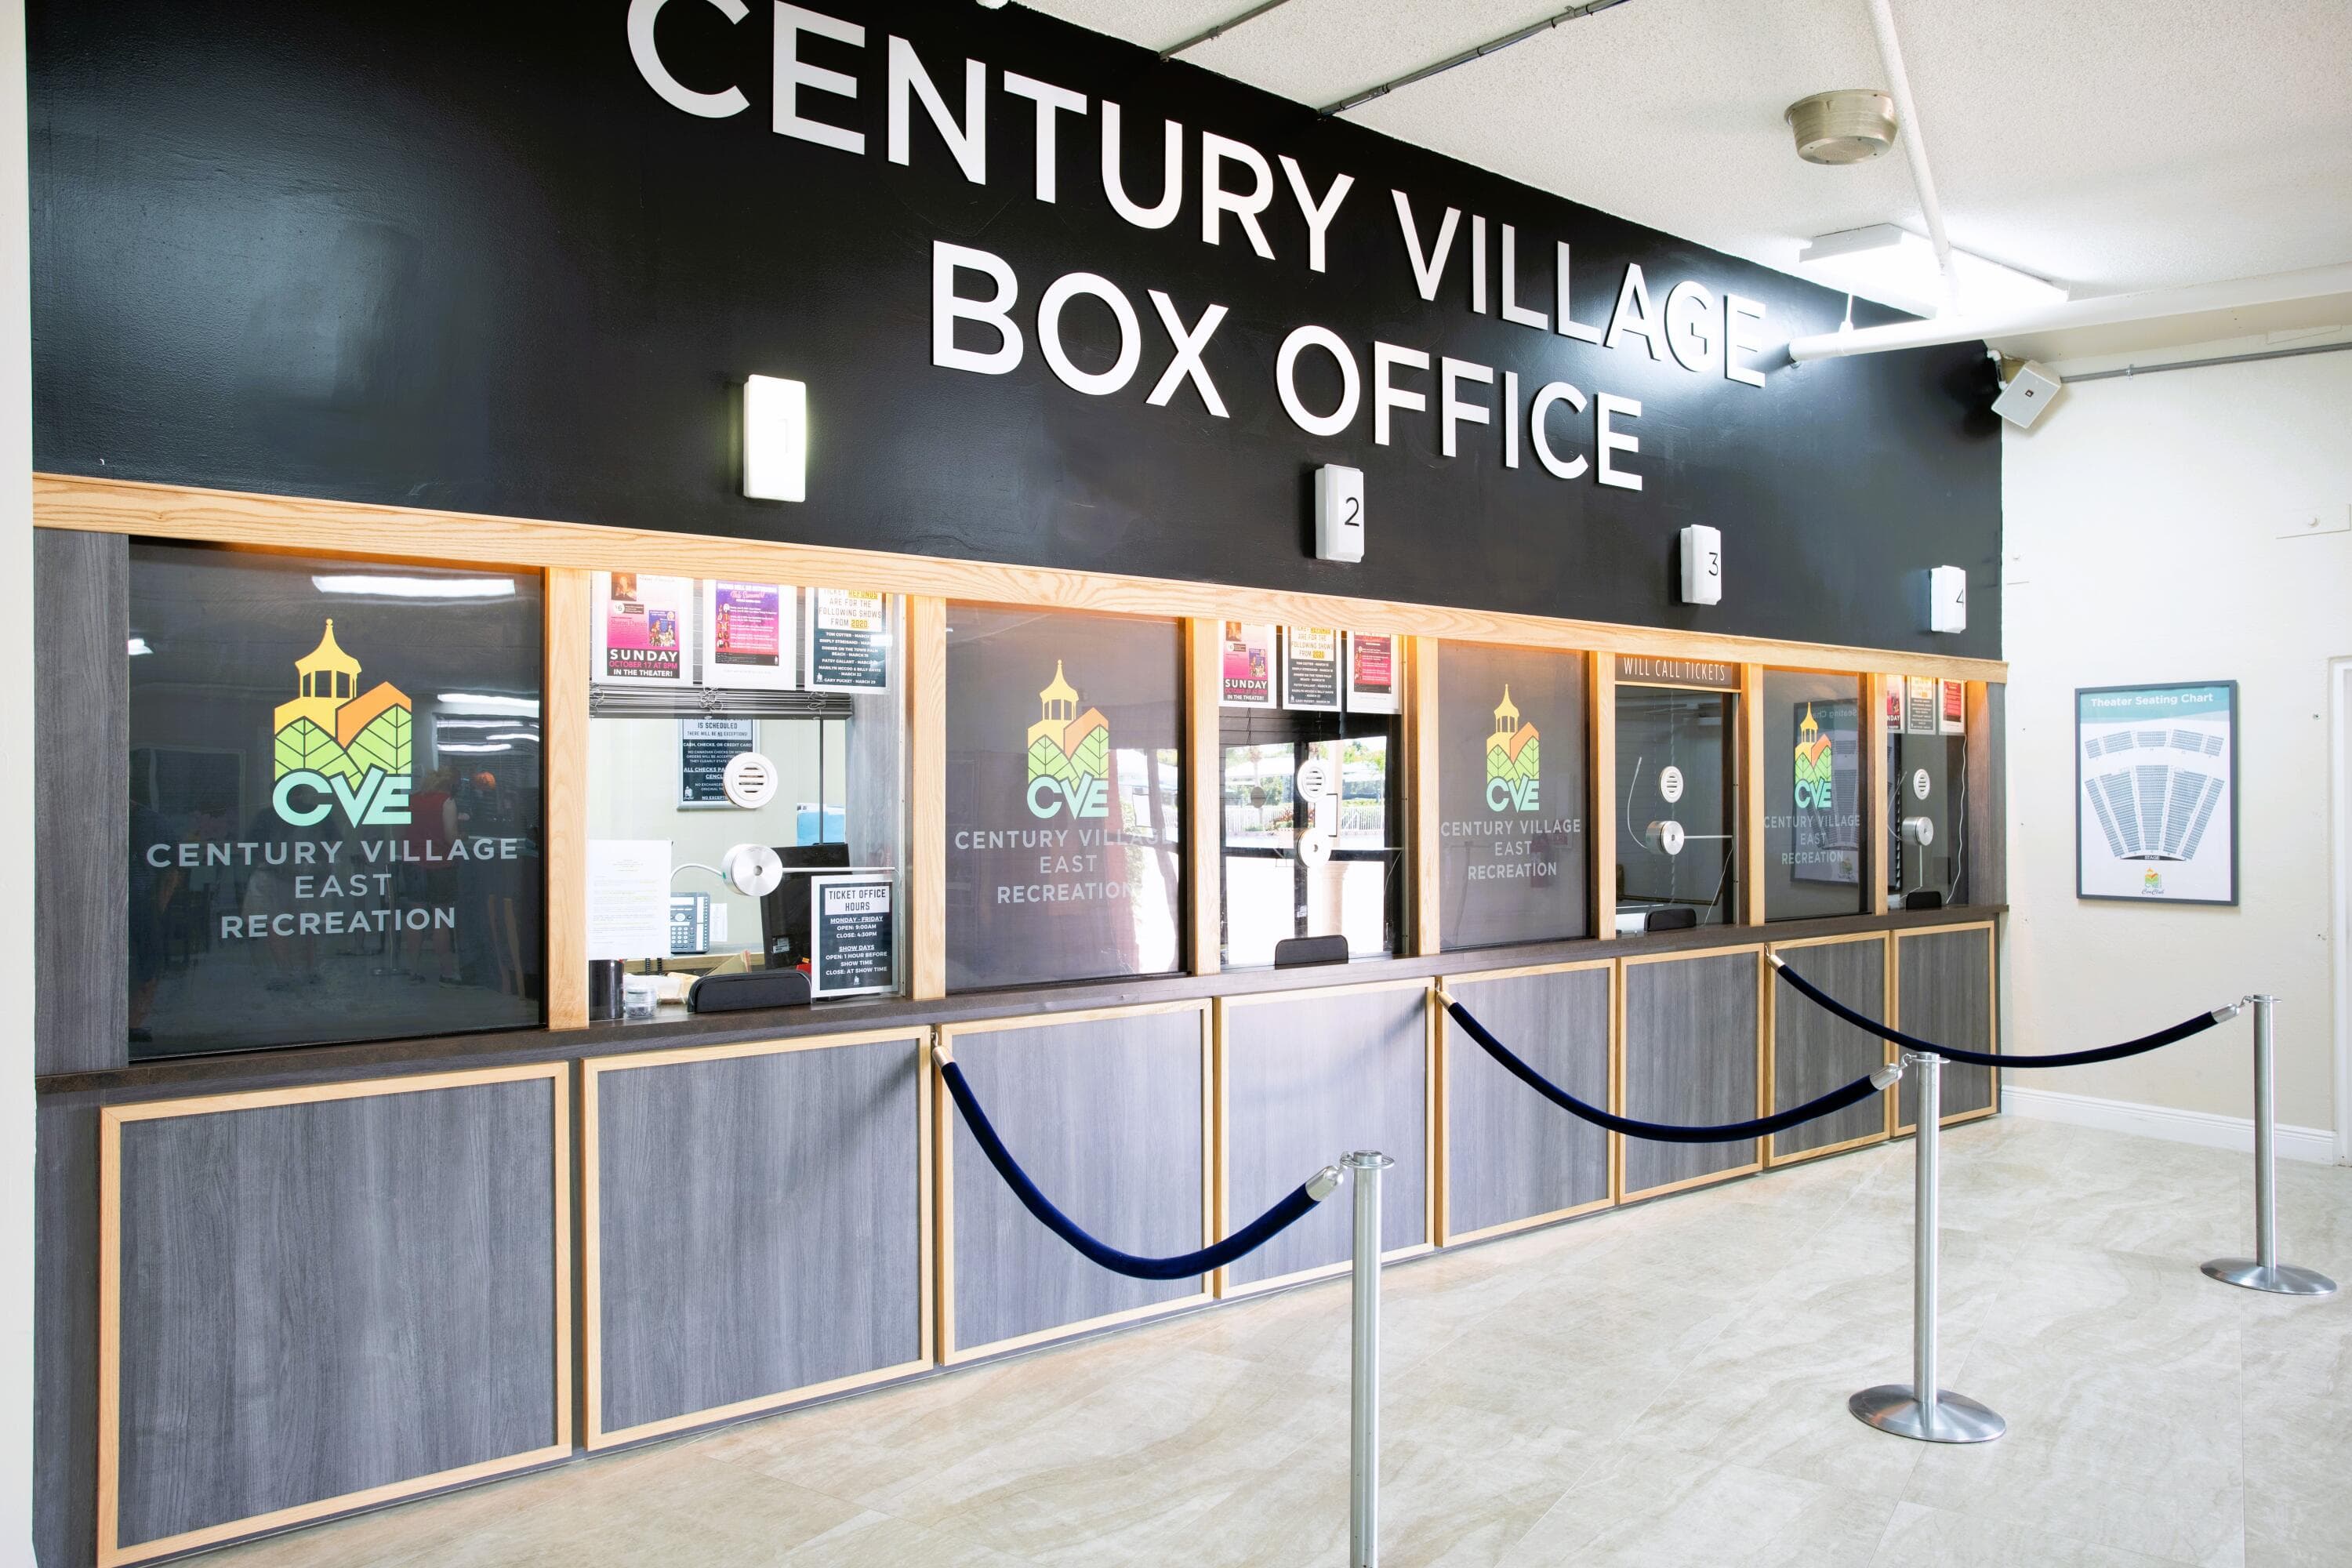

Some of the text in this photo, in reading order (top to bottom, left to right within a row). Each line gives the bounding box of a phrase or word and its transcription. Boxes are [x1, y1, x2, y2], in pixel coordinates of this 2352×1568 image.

[628, 0, 1766, 388] CENTURY VILLAGE
[932, 239, 1642, 491] BOX OFFICE
[1345, 496, 1360, 527] 2
[1708, 552, 1719, 576] 3
[829, 597, 842, 606] ARE
[844, 598, 857, 607] FOR
[1956, 588, 1964, 608] 4
[818, 607, 881, 619] FOLLOWING SHOWS
[831, 618, 848, 626] FROM
[610, 649, 677, 662] SUNDAY
[1624, 657, 1725, 681] WILL CALL TICKETS
[1225, 679, 1267, 688] SUNDAY
[2091, 692, 2214, 707] Theater Seating Chart
[273, 765, 412, 829] CVE
[1027, 771, 1109, 820] CVE
[1486, 773, 1539, 813] CVE
[1795, 777, 1831, 809] CVE
[1441, 818, 1581, 837] CENTURY VILLAGE
[1764, 815, 1860, 829] CENTURY VILLAGE
[955, 829, 1069, 850] CENTURY
[1495, 840, 1532, 856] EAST
[1800, 833, 1827, 845] EAST
[147, 837, 517, 867] CENTURY VILLAGE
[1782, 851, 1843, 865] RECREATION
[1040, 855, 1097, 873] EAST
[1468, 862, 1557, 880] RECREATION
[295, 873, 392, 899] EAST
[829, 889, 886, 899] TICKET OFFICE
[997, 882, 1133, 903] RECREATION
[845, 902, 870, 911] HOURS
[221, 906, 456, 939] RECREATION
